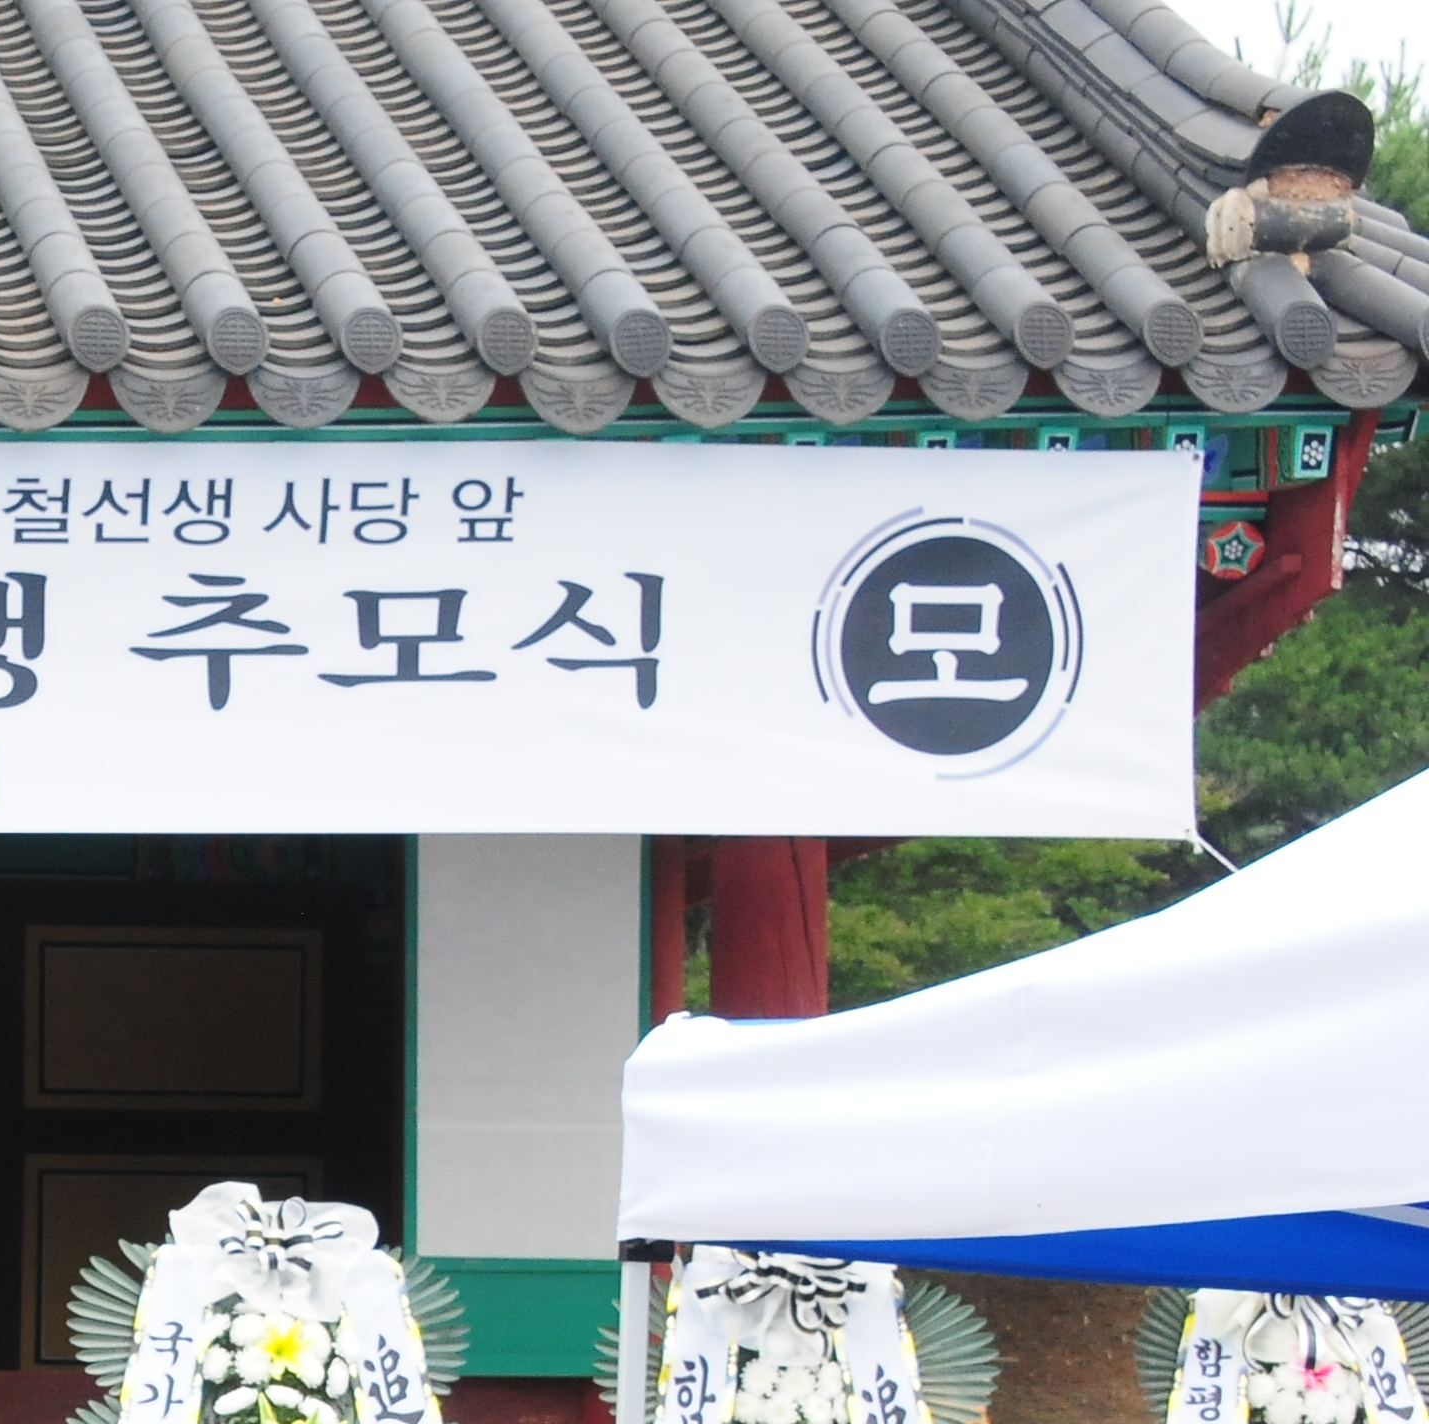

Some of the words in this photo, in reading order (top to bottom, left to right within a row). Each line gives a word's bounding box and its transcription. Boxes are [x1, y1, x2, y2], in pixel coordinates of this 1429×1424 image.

[263, 477, 421, 545] 사당
[451, 477, 525, 543] 앞
[129, 572, 664, 710] 추모식
[867, 580, 1030, 703] 모
